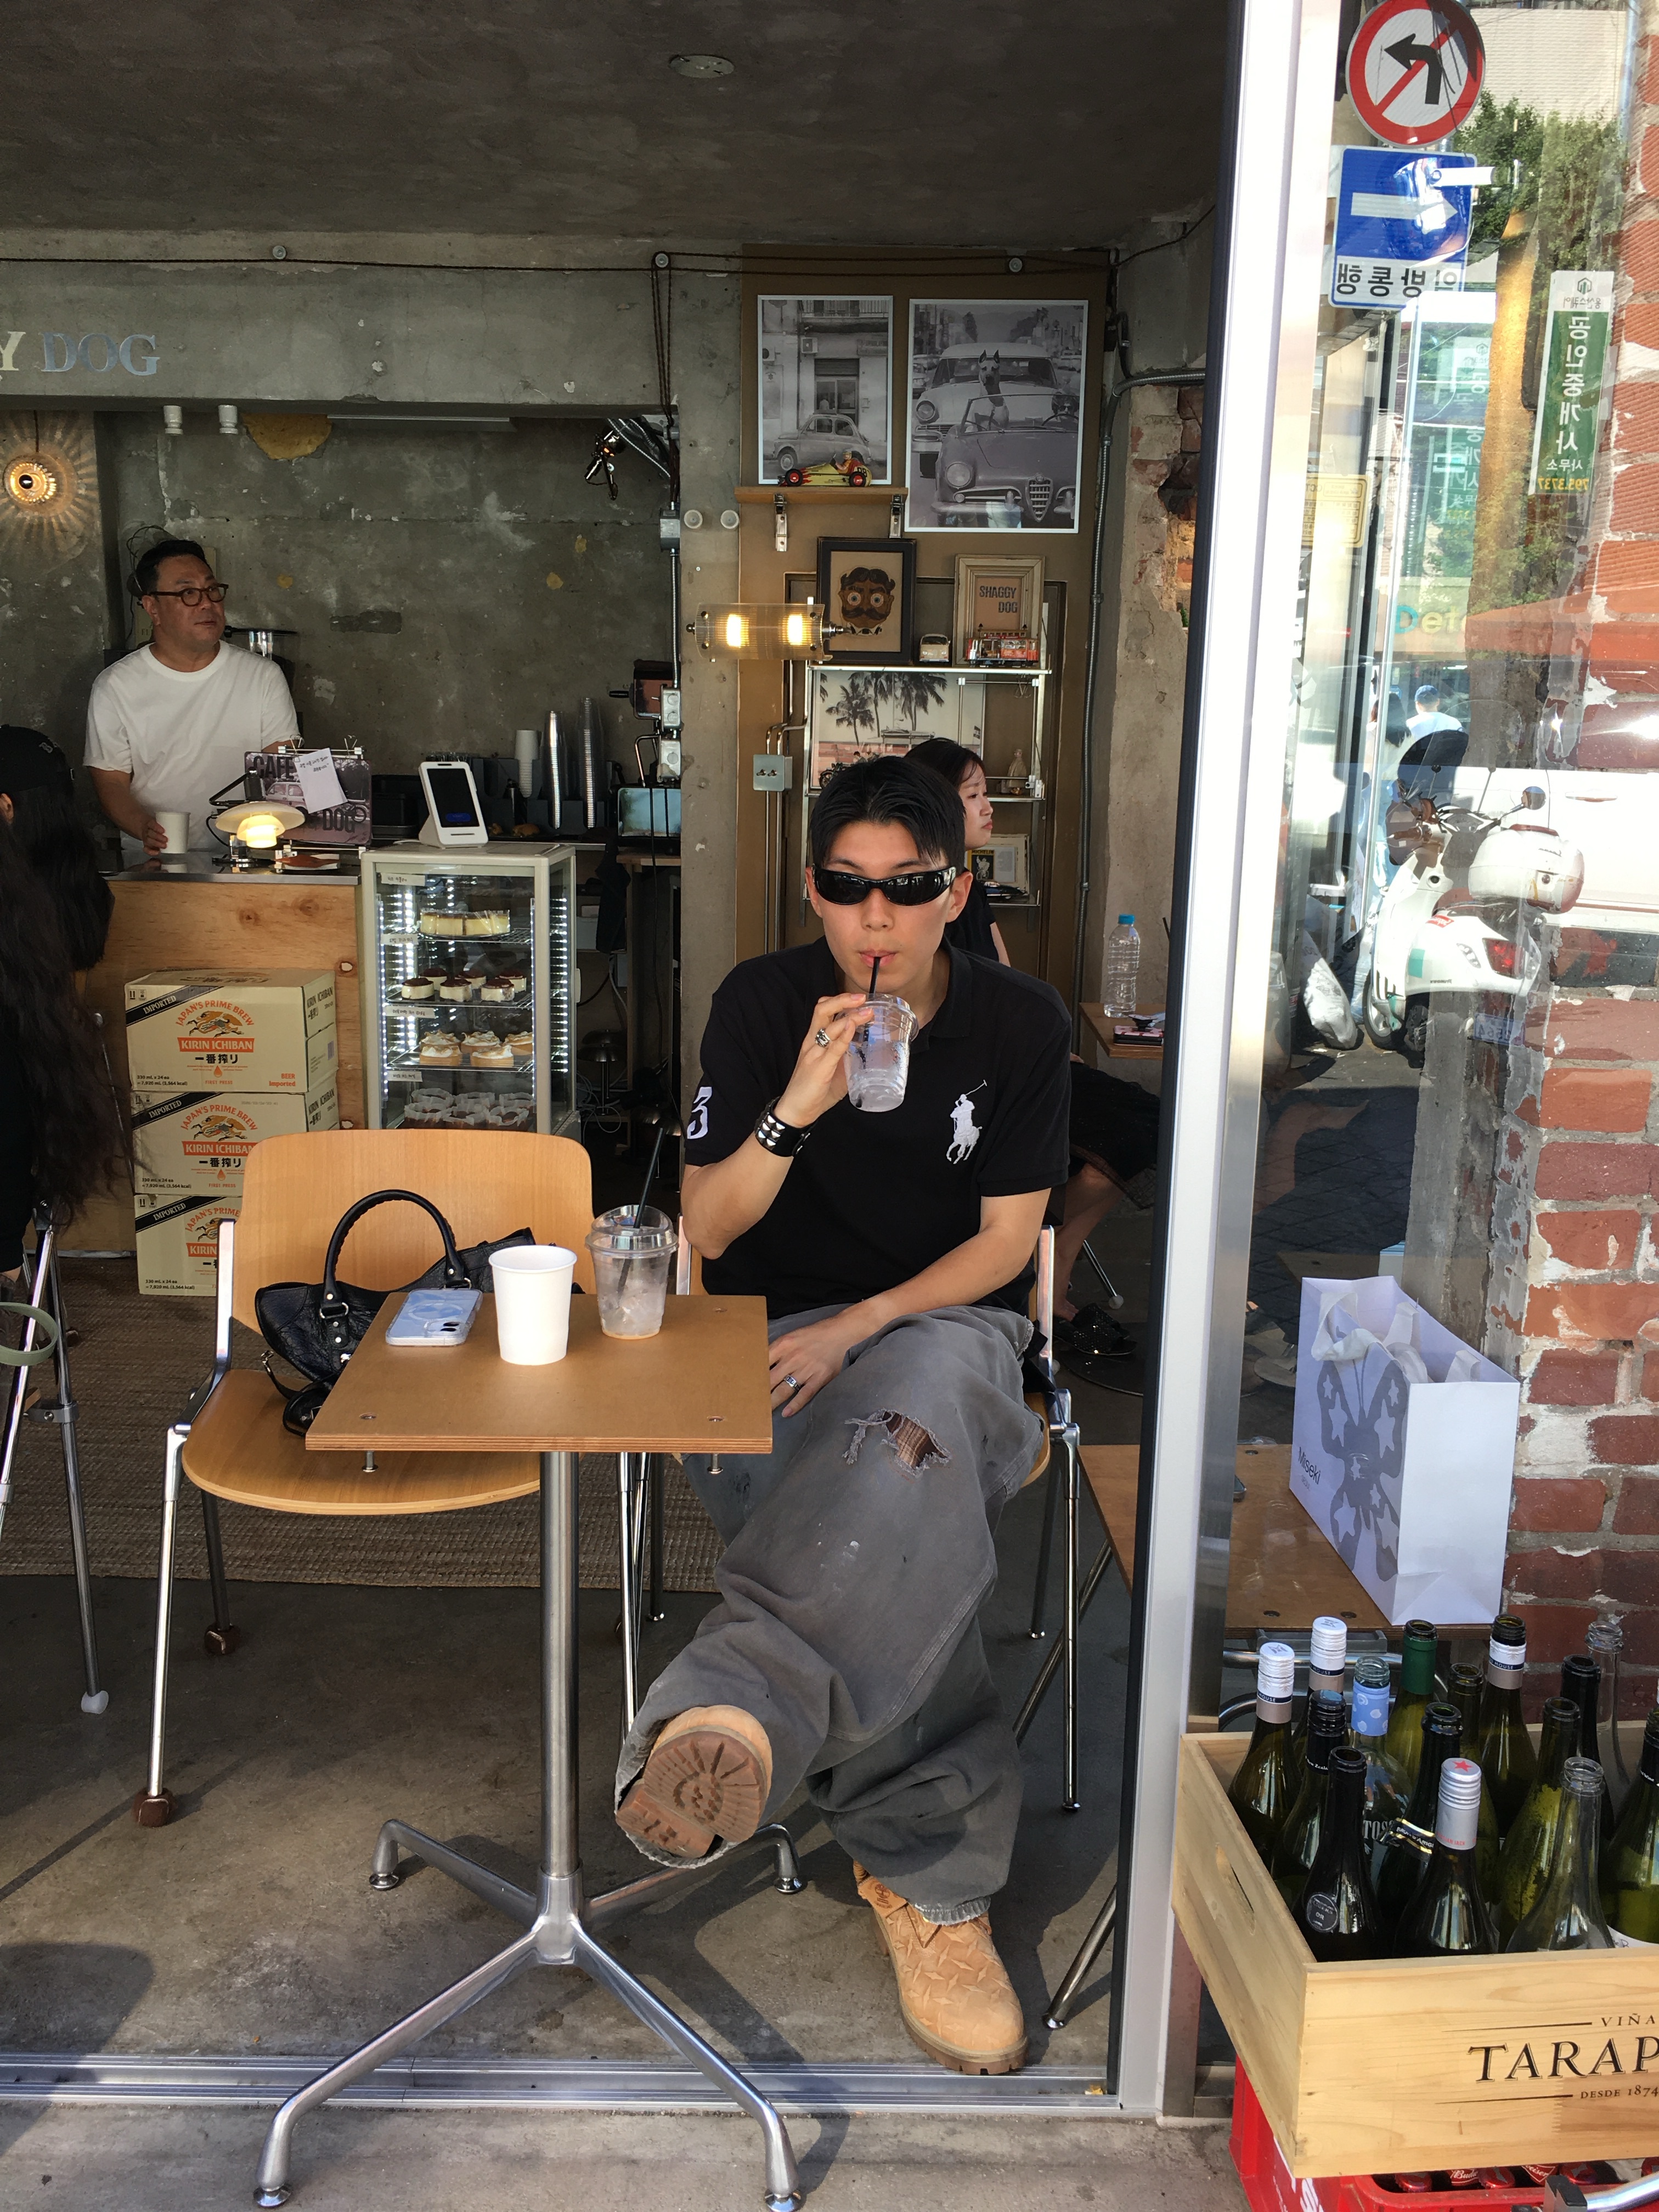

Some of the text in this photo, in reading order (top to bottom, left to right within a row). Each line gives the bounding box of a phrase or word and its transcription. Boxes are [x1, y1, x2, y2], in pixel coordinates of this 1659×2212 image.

[38, 332, 160, 376] DOG
[979, 585, 1017, 598] SHAGGY
[998, 602, 1018, 613] DOG
[253, 755, 295, 778] CAFE
[323, 807, 356, 833] DOG
[143, 995, 177, 1014] IMPORTED
[176, 1000, 255, 1026] JAPAN'S PRIME BREW
[181, 1040, 252, 1050] KIRIN ICHIBAN
[148, 1100, 182, 1119] IMPORTED
[180, 1104, 258, 1130] JAPAN'S PRIME BREW
[185, 1144, 213, 1153] KIRIN
[153, 1203, 187, 1221] IMPORTED
[185, 1207, 241, 1232] JAPAN'S PRIME
[190, 1246, 217, 1255] KIRIN
[1298, 1446, 1321, 1485] Miseki
[1313, 1666, 1330, 1675] HOUSE
[1494, 1661, 1514, 1670] HOUSE
[1259, 1693, 1276, 1702] HOUSE
[1601, 2013, 1656, 2027] VIÑA
[1581, 2084, 1658, 2099] DESDE 1874
